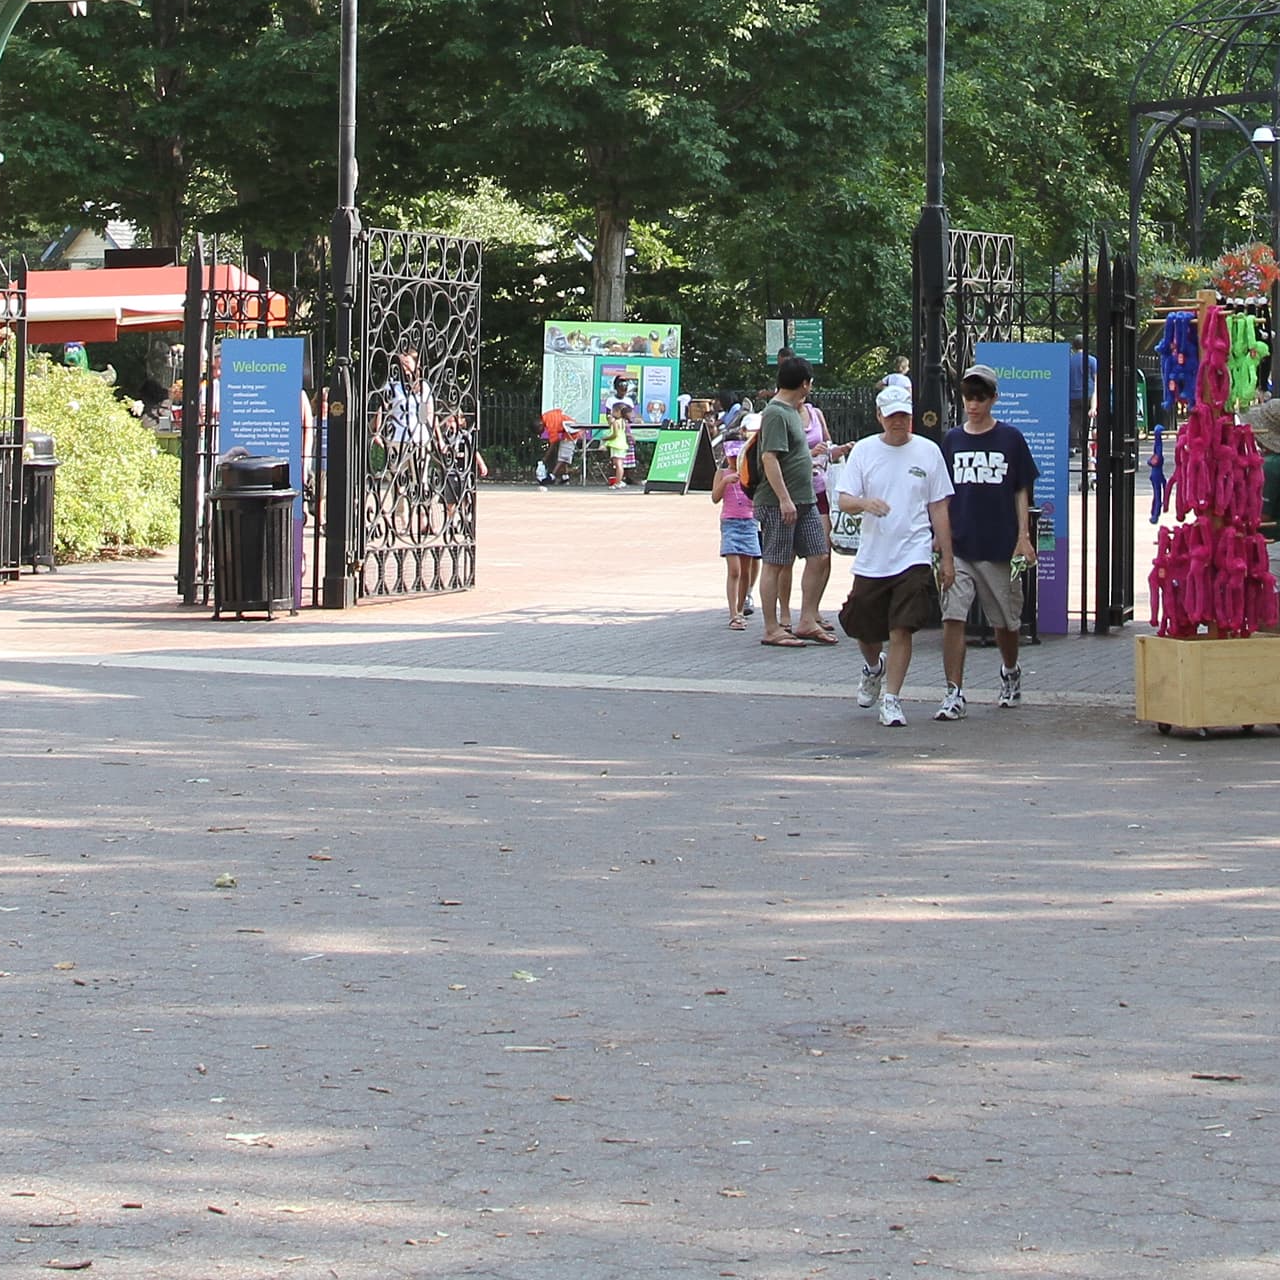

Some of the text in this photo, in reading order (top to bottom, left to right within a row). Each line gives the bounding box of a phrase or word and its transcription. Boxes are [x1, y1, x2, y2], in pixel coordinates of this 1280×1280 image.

[232, 360, 287, 373] Welcome
[658, 438, 692, 453] STOP IN
[952, 450, 1009, 469] STAR
